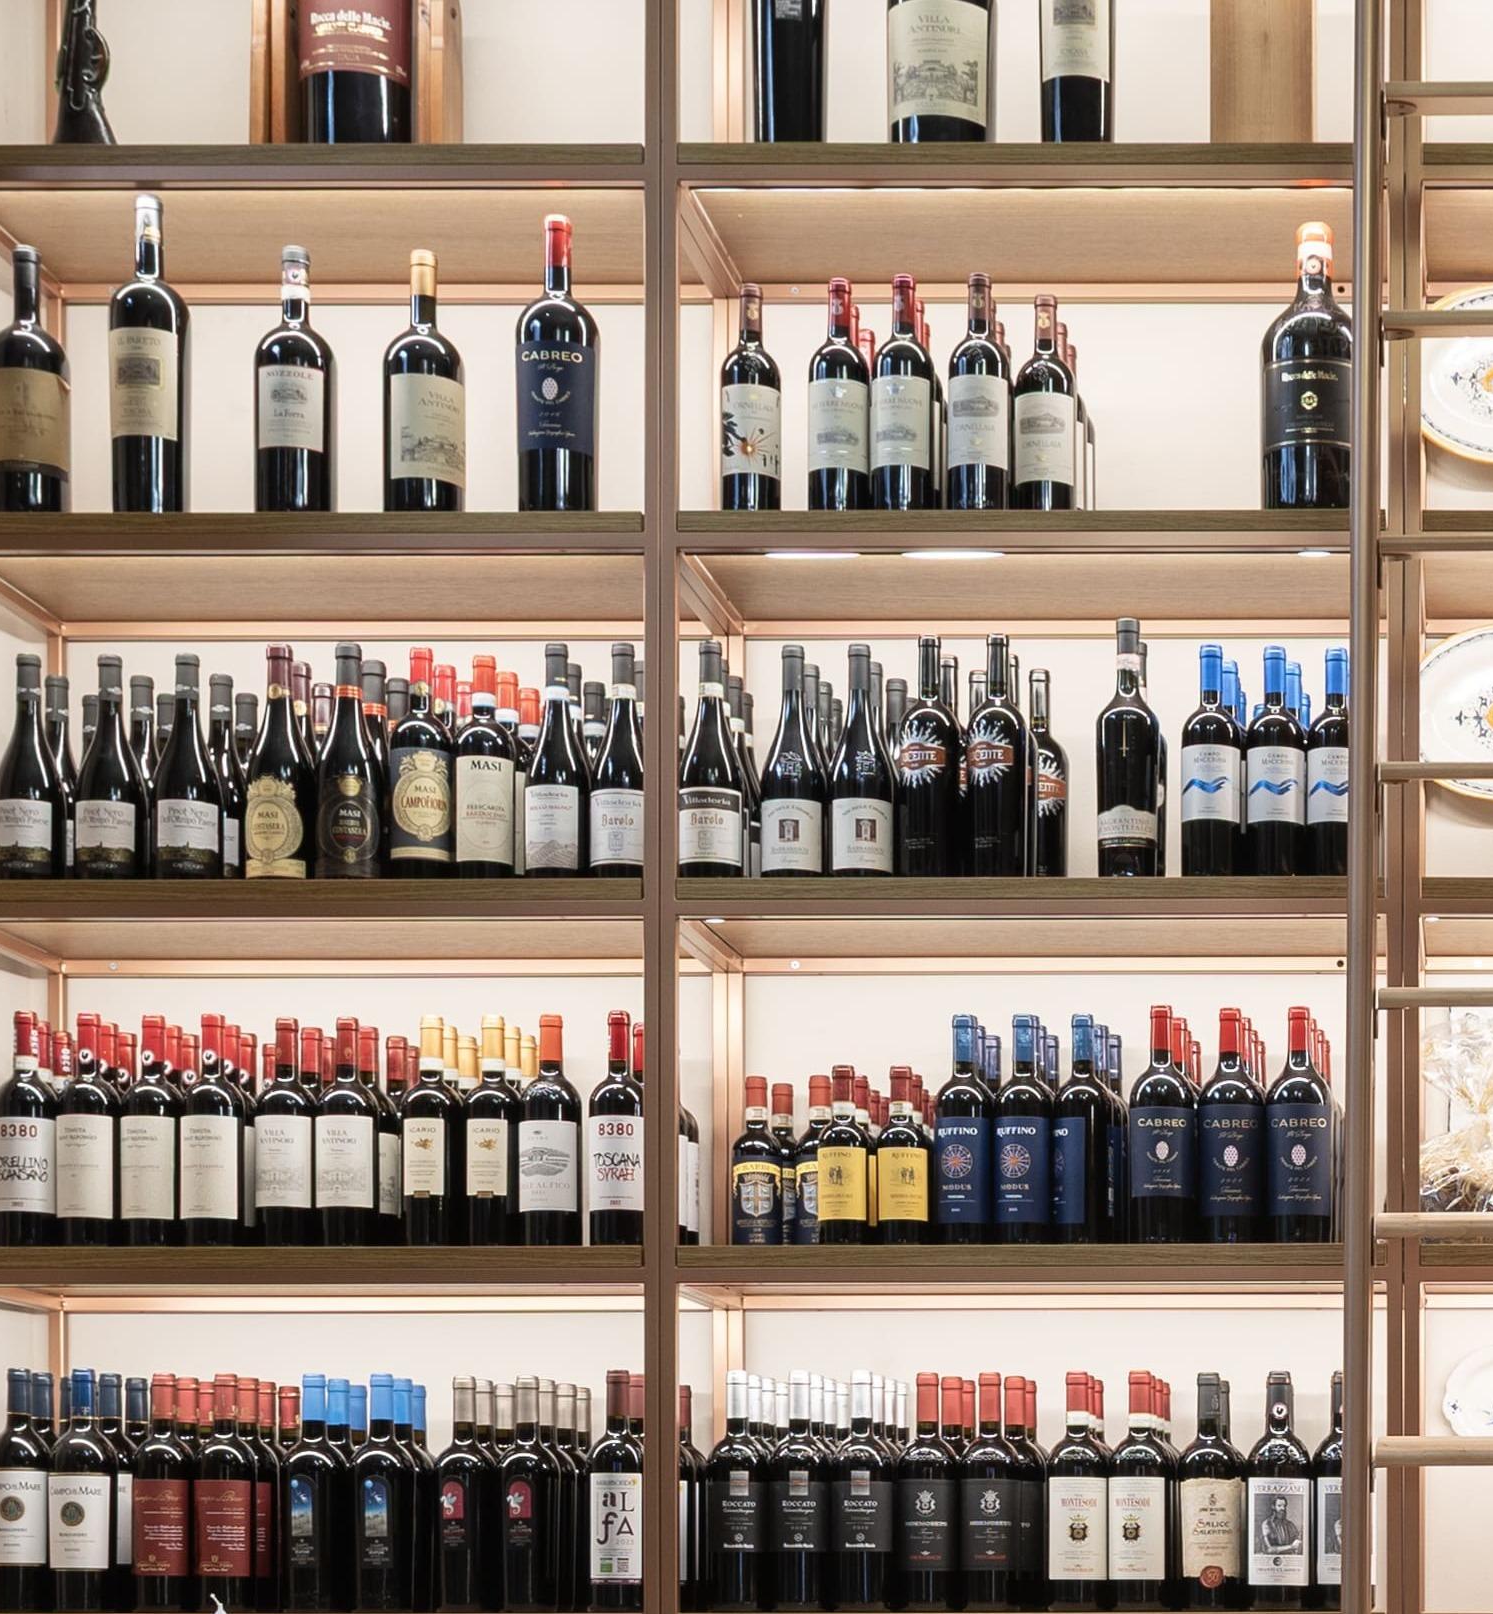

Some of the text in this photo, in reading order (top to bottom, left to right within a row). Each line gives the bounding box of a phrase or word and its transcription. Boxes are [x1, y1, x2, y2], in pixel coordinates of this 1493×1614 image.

[521, 350, 583, 364] CABREO
[470, 760, 502, 772] MASI
[414, 785, 437, 794] MASI
[257, 811, 278, 819] MASI
[338, 808, 360, 817] MASI
[601, 814, 634, 827] Barolo
[690, 812, 724, 826] Barolo
[1137, 1118, 1187, 1128] CABREO
[1203, 1118, 1258, 1129] CABREO
[1270, 1118, 1327, 1129] CABREO
[1, 1125, 37, 1137] 8380
[326, 1128, 348, 1136] VILLA
[409, 1126, 437, 1134] ICARIO
[472, 1126, 500, 1134] ICARIO
[599, 1123, 634, 1136] 8380
[937, 1127, 978, 1137] RUFFINO
[996, 1126, 1037, 1136] RUFFINO
[594, 1152, 641, 1168] TOSCANA
[822, 1151, 852, 1159] RUFFINO
[891, 1151, 923, 1159] RUFFINO
[597, 1168, 634, 1181] SYRAH
[1000, 1183, 1030, 1191] MODUS
[18, 1481, 42, 1491] MARE
[50, 1486, 102, 1496] CAMPO MARE
[1195, 1519, 1230, 1528] SALICE
